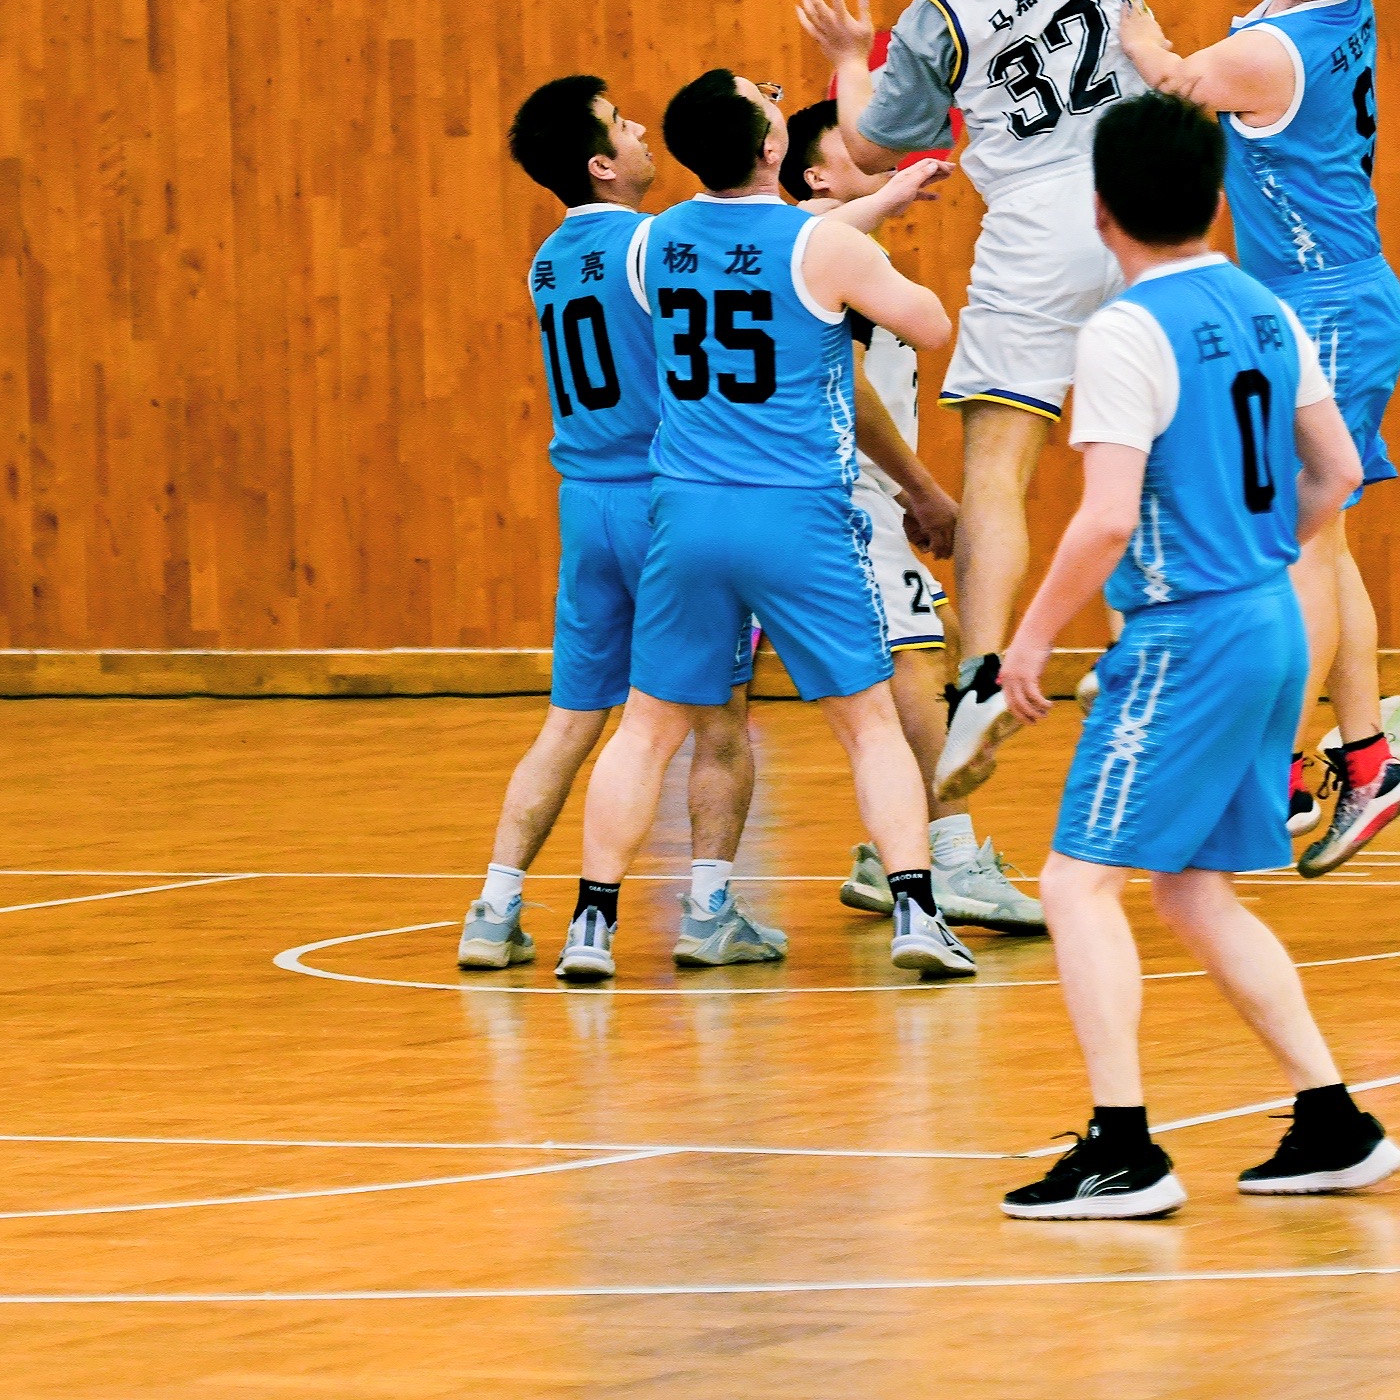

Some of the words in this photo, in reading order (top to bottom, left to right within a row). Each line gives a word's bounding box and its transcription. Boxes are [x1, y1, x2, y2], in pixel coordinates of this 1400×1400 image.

[534, 250, 606, 292] 吴亮
[663, 241, 762, 276] 杨龙
[541, 295, 621, 418] 10
[658, 287, 777, 404] 35
[1230, 368, 1276, 515] 0
[902, 570, 931, 616] 2
